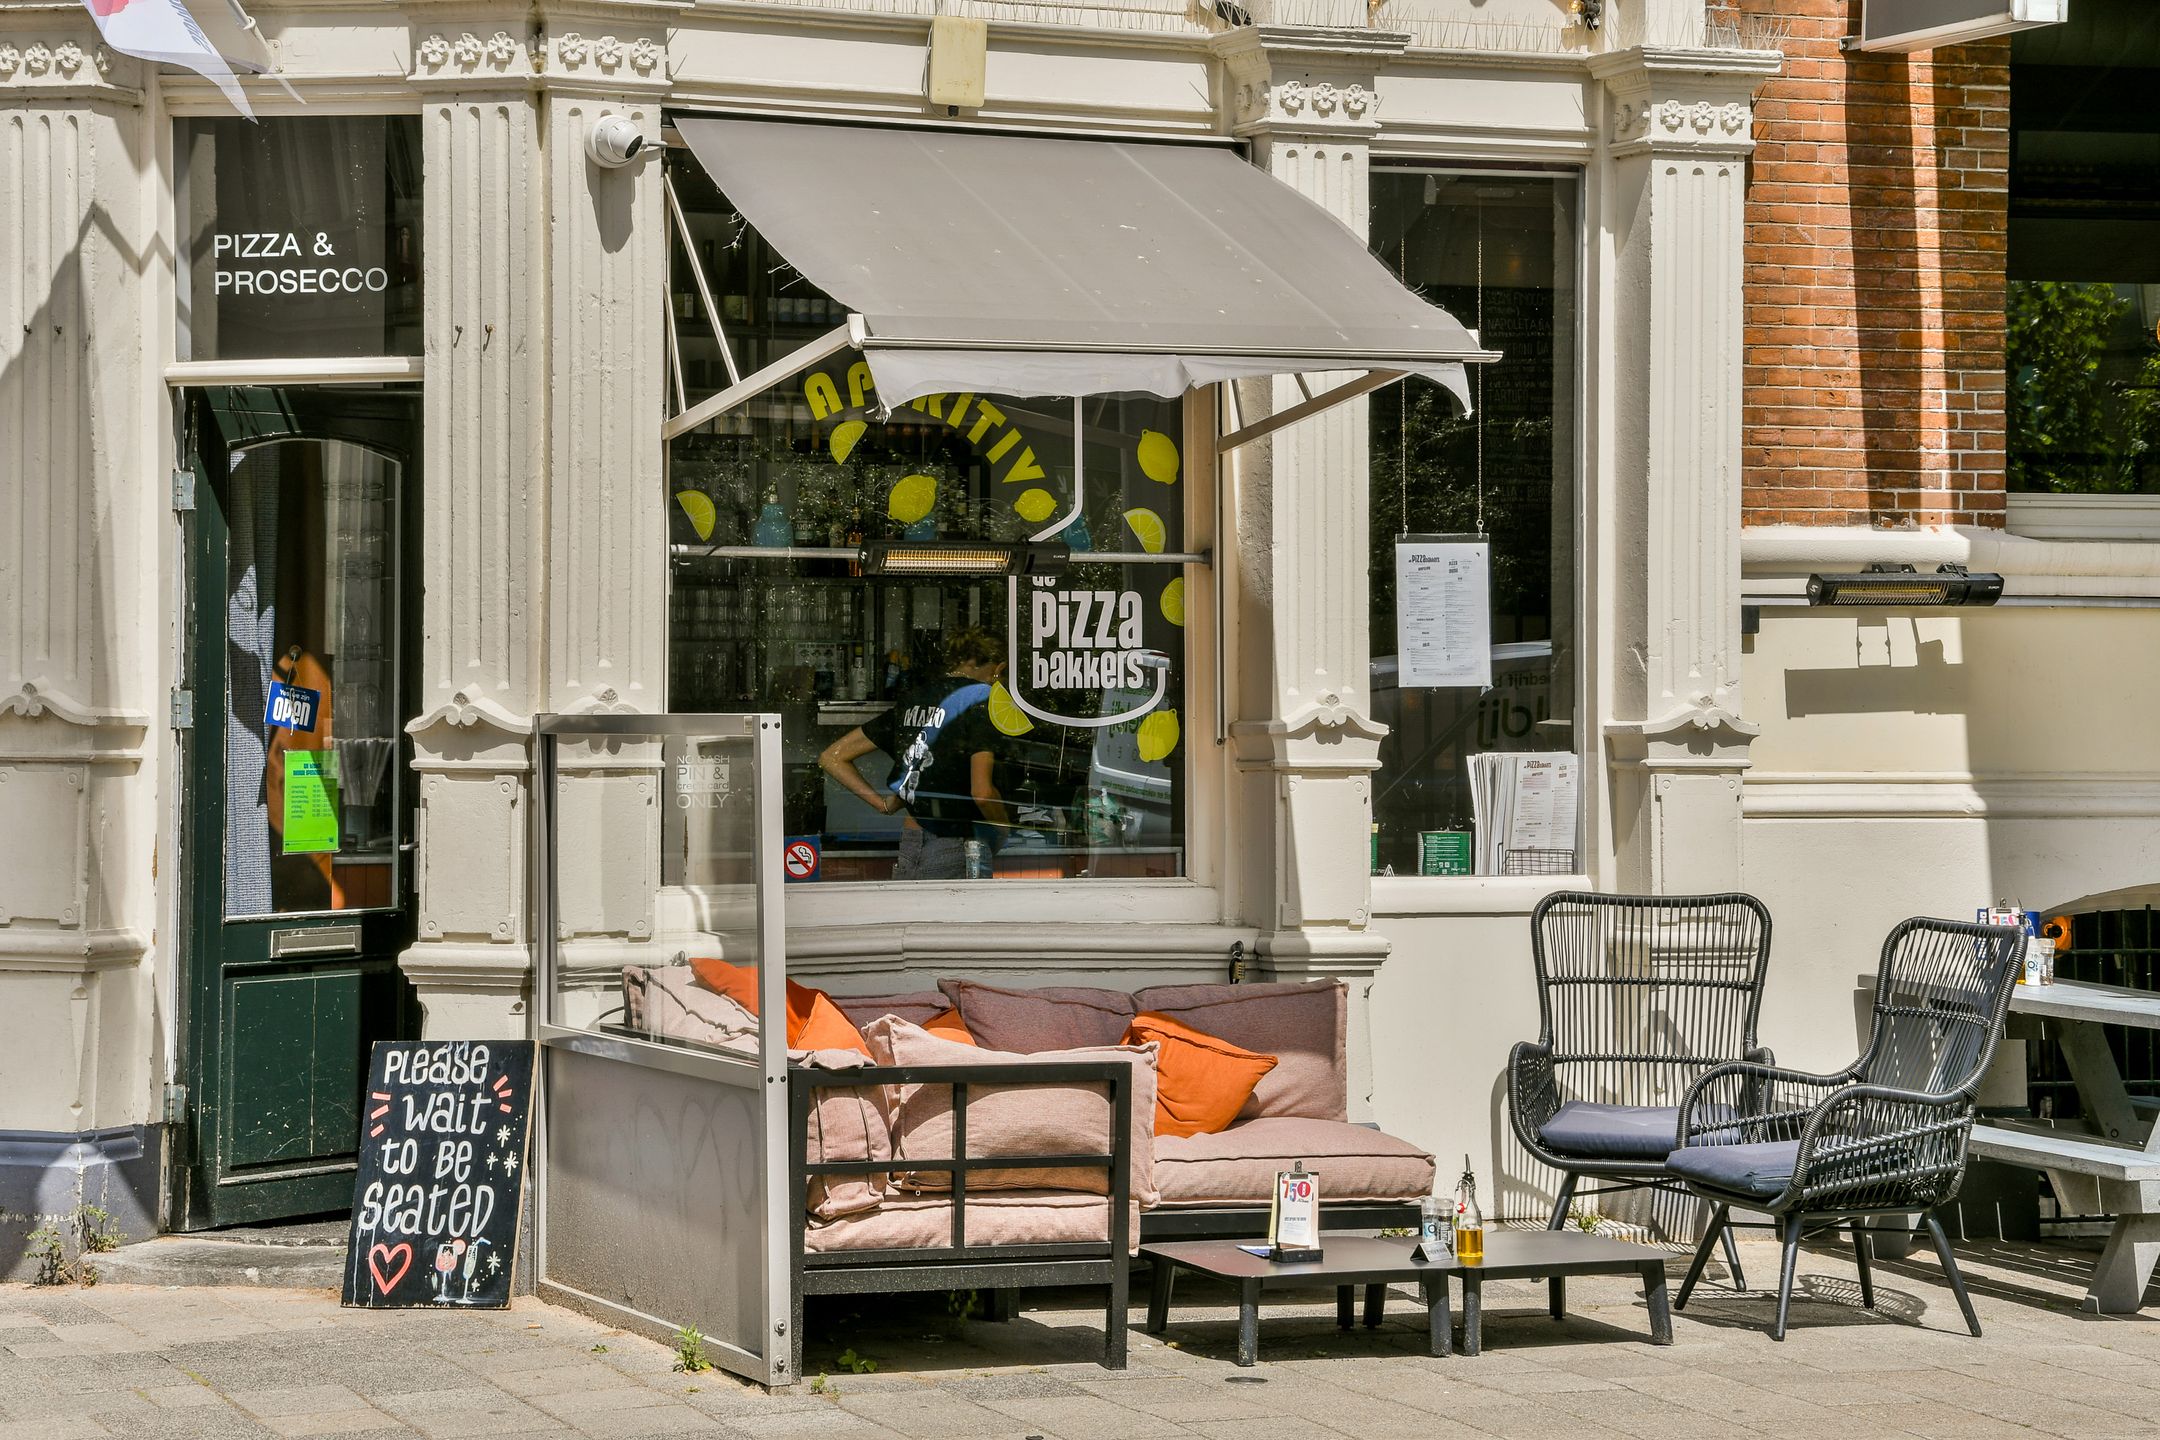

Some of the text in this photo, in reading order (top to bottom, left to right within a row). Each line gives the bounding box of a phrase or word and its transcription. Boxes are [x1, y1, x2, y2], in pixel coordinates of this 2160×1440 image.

[213, 231, 336, 259] PIZZA &
[214, 267, 388, 295] PROSECCO
[1032, 590, 1143, 649] pizza
[1032, 650, 1144, 690] bakkers
[272, 696, 311, 727] open
[676, 754, 730, 765] NO CASH
[677, 766, 725, 780] PIN &
[707, 781, 730, 790] card
[676, 793, 729, 809] ONLY
[381, 1138, 418, 1175] to
